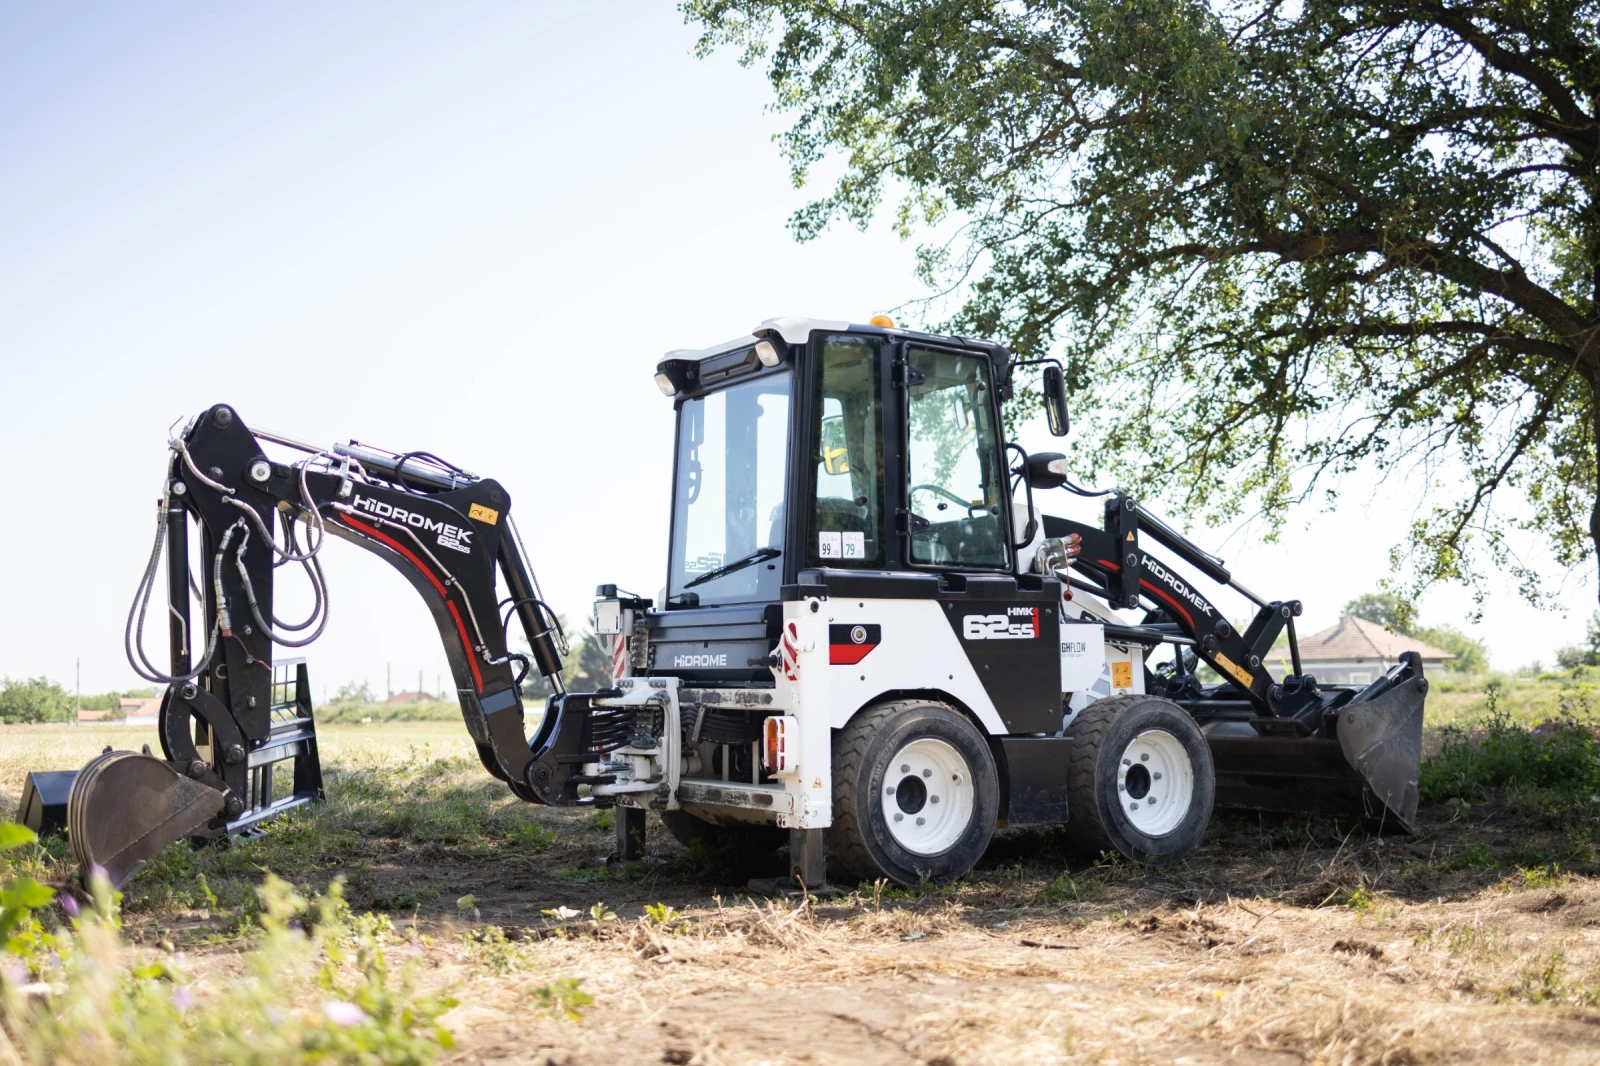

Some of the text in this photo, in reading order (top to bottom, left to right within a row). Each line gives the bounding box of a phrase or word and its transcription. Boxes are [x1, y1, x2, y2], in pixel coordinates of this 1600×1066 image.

[822, 543, 831, 555] 99
[845, 543, 855, 556] 79
[1007, 607, 1034, 616] HMK
